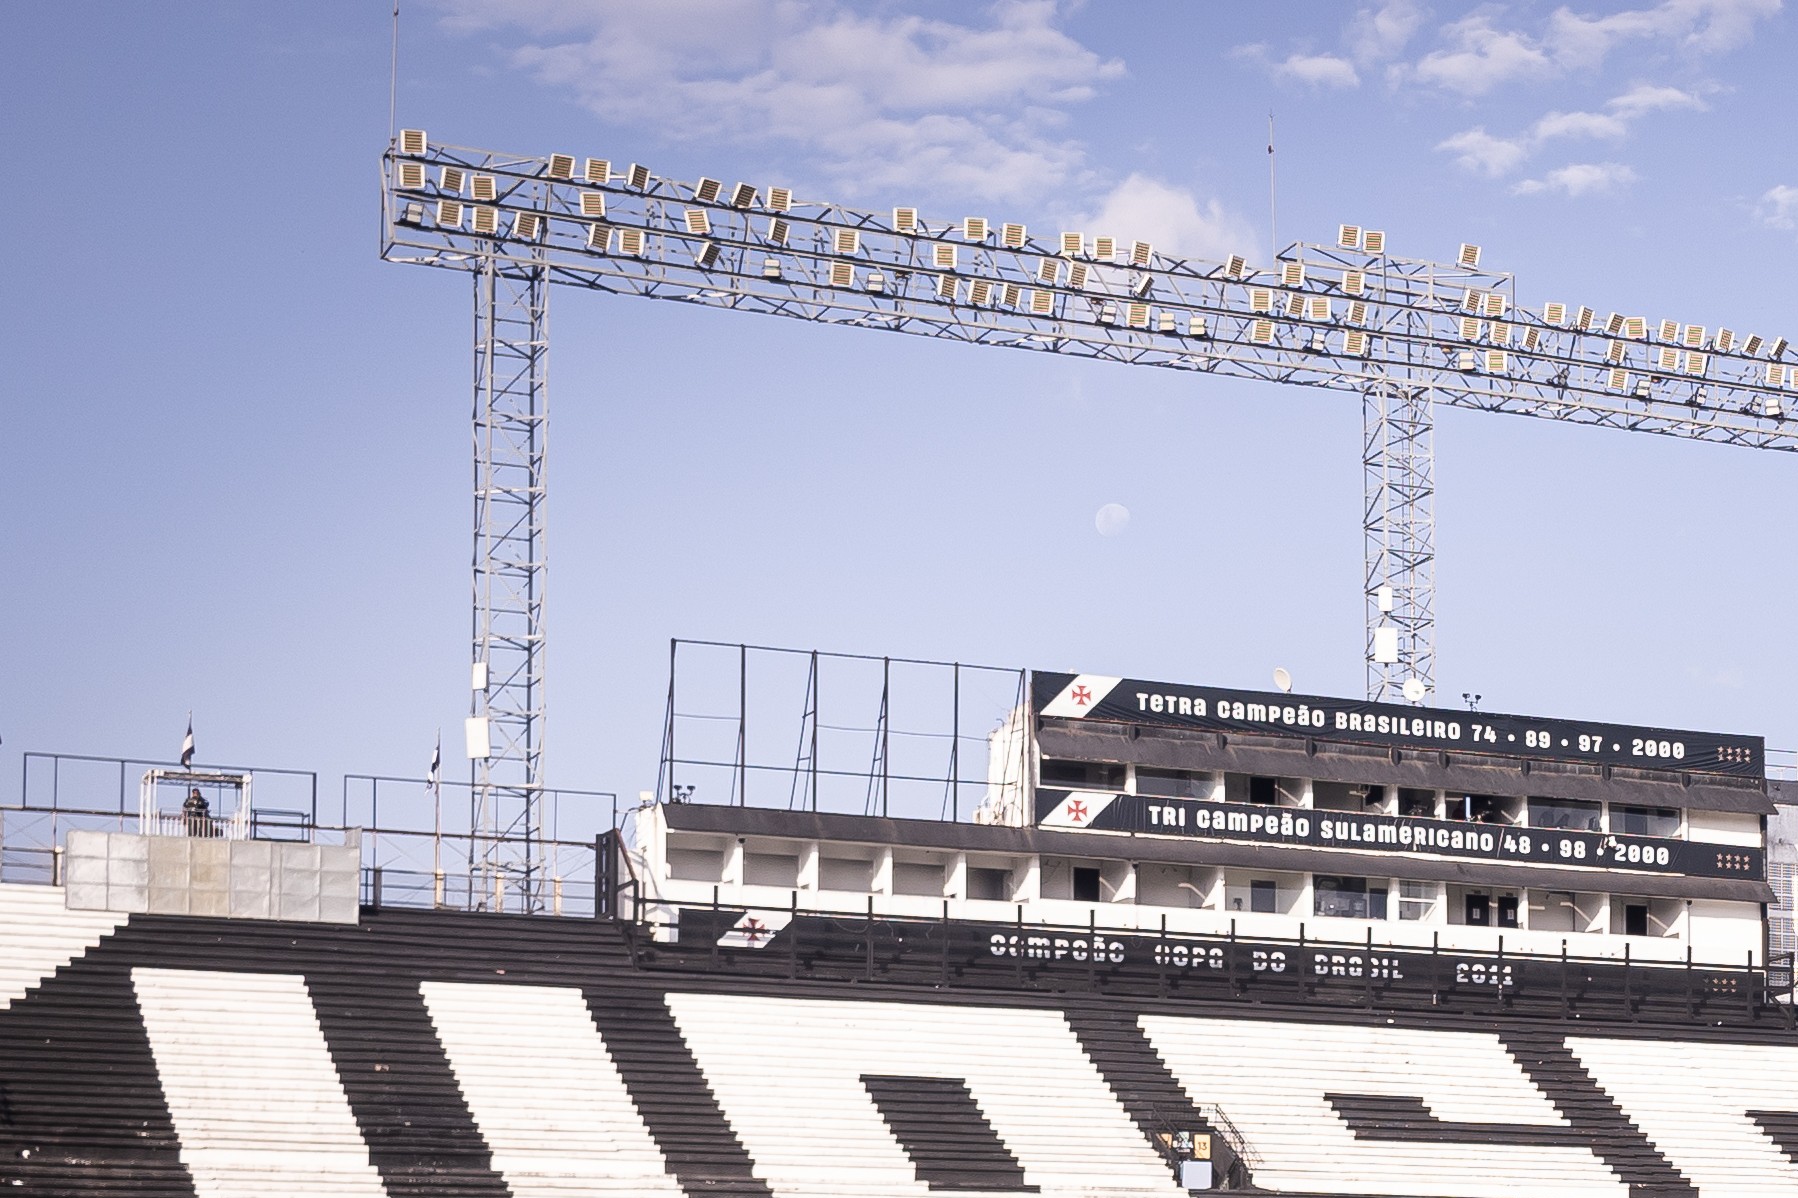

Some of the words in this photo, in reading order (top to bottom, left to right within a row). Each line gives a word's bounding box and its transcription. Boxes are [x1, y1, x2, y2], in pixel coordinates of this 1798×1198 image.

[1471, 724, 1497, 744] 74
[1525, 730, 1551, 749] 89
[1578, 734, 1603, 753] 97
[1632, 738, 1685, 760] 2000
[1148, 805, 1186, 827] TRI
[1503, 834, 1531, 855] 48
[1559, 839, 1586, 859] 98
[1614, 843, 1669, 866] 2000
[1252, 951, 1286, 972] DO
[1456, 963, 1513, 986] 2011
[1197, 1141, 1208, 1151] 13
